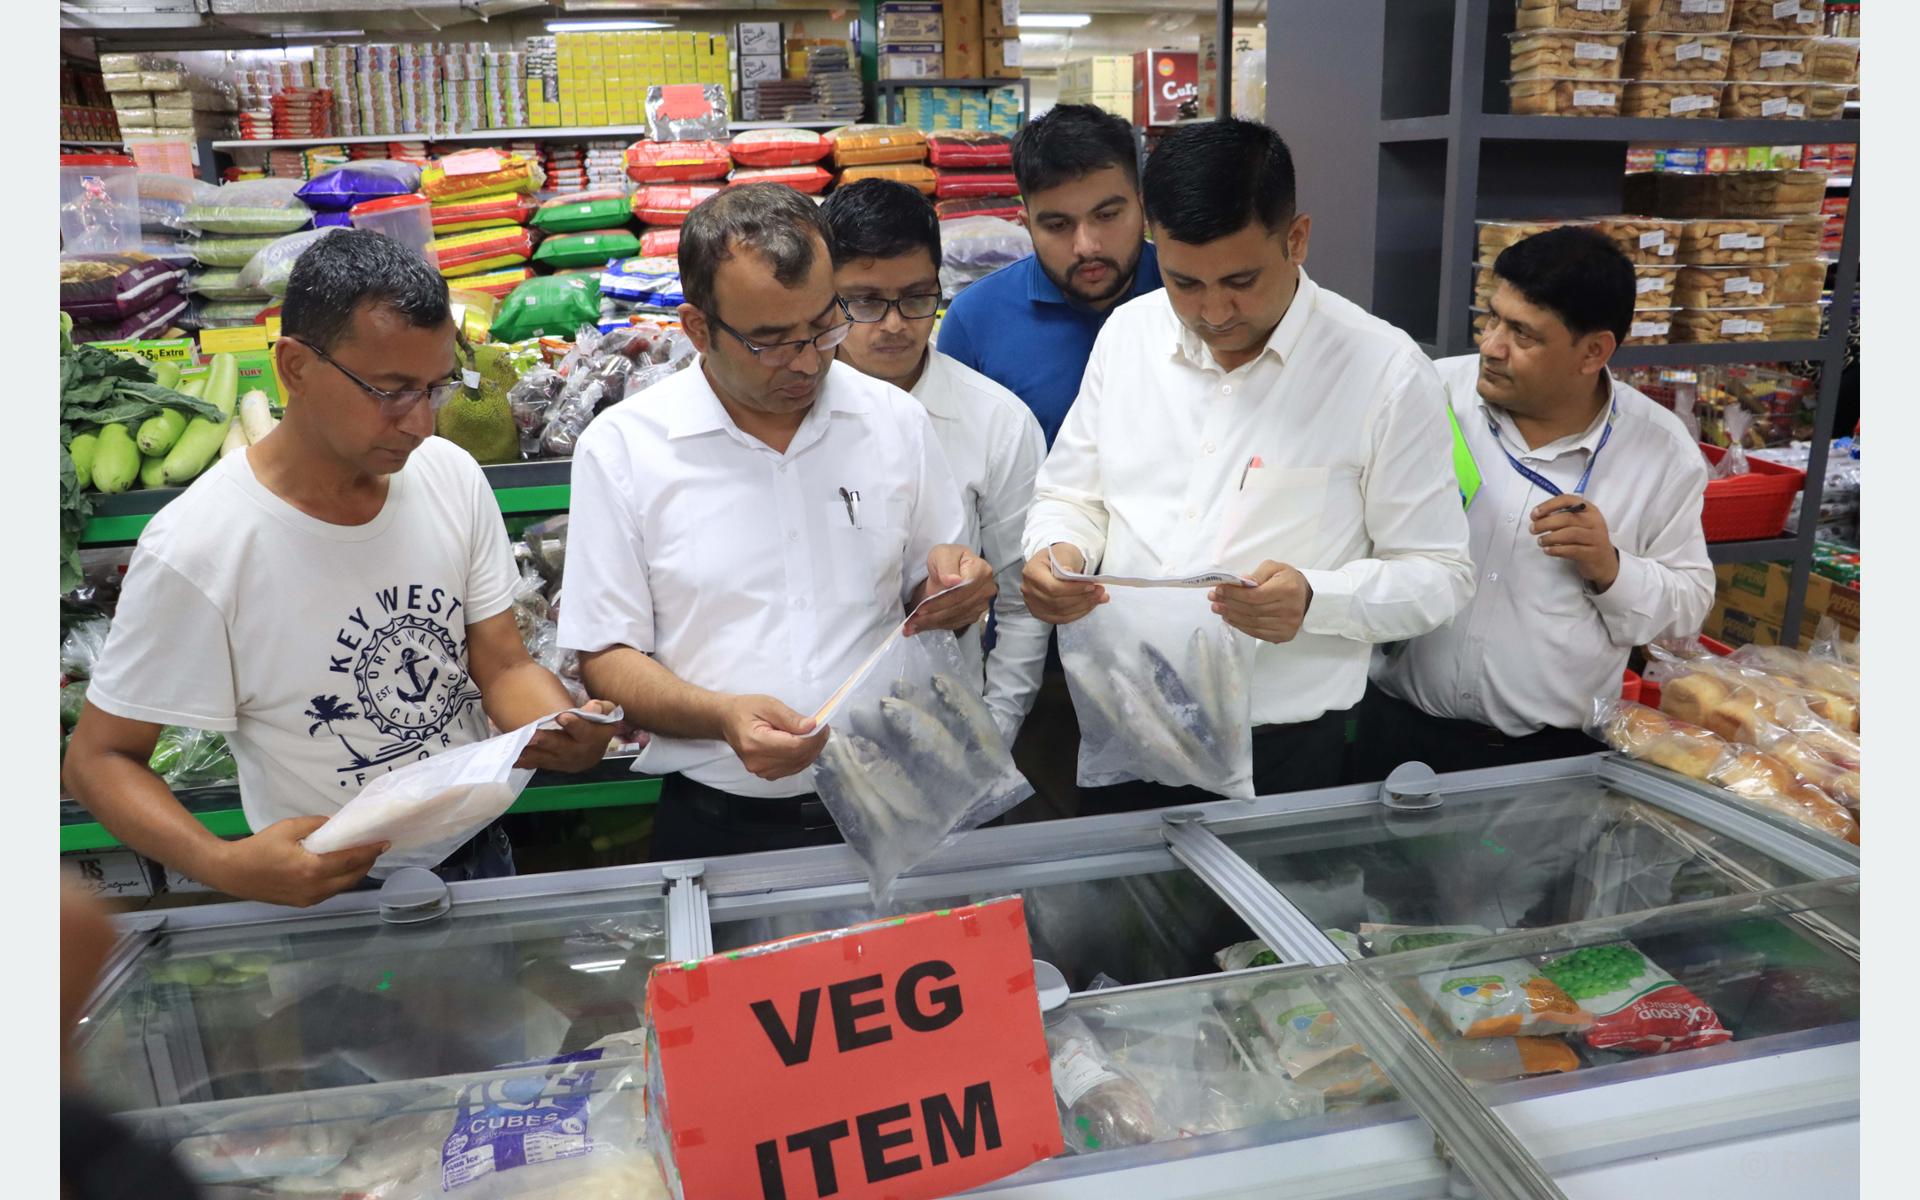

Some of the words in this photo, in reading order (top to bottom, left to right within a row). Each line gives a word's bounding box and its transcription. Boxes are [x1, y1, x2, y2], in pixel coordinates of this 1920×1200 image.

[159, 348, 184, 357] Extra
[329, 606, 370, 674] KEY
[375, 584, 462, 622] WEST
[367, 629, 435, 680] ORIGINAL
[375, 685, 393, 702] EST.
[389, 672, 459, 725] CLASSIC
[749, 959, 965, 1067] VEG
[1632, 1001, 1692, 1012] PRODUCTS
[1638, 1008, 1682, 1020] FOOD
[468, 1062, 581, 1116] ICE
[470, 1112, 560, 1134] CUBES
[754, 1081, 1003, 1200] ITEM
